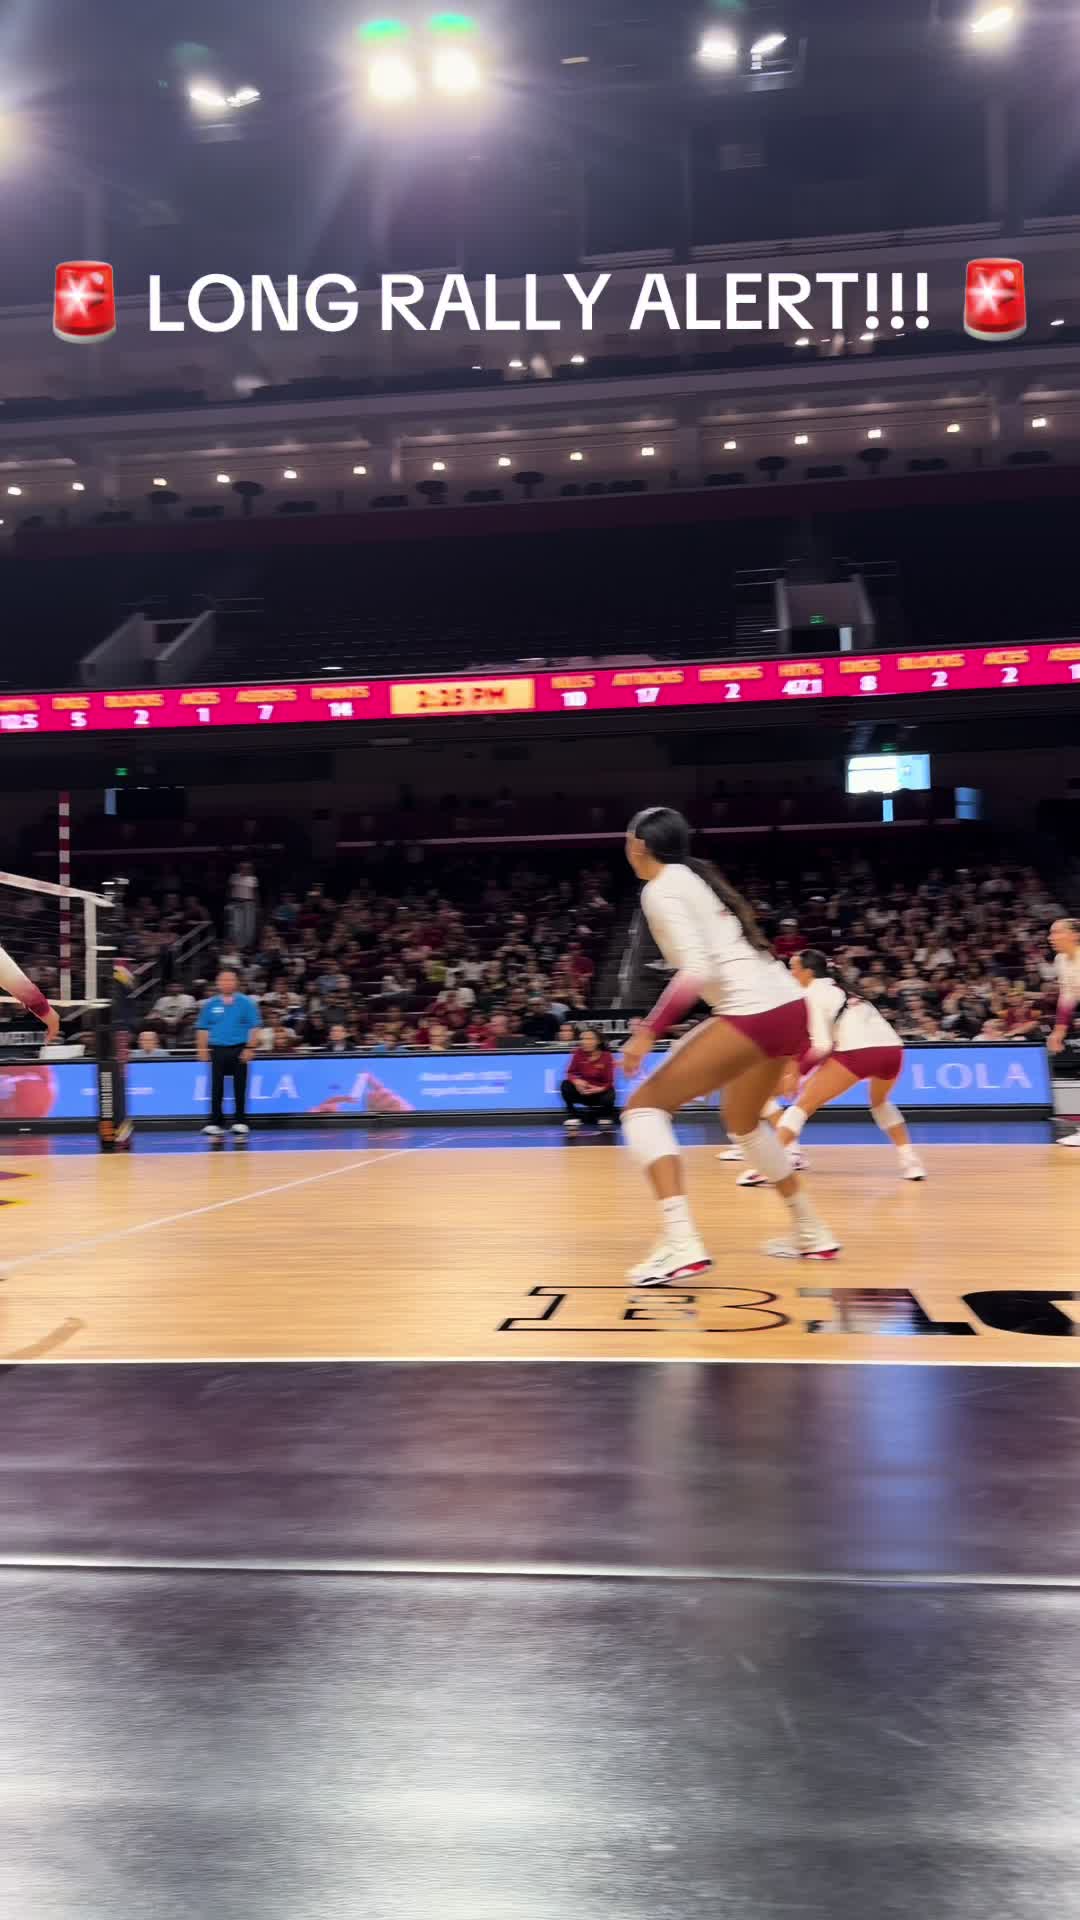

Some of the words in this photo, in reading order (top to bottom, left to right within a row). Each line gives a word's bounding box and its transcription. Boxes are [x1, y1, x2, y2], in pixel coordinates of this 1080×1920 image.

[724, 682, 741, 699] 2
[859, 675, 878, 691] 8
[931, 671, 949, 688] 2
[1001, 666, 1019, 684] 2
[70, 711, 88, 728] 5
[133, 709, 150, 725] 2
[196, 707, 211, 723] 1
[257, 704, 275, 720] 7
[193, 1074, 300, 1101] LLA
[911, 1063, 1033, 1089] LOLA
